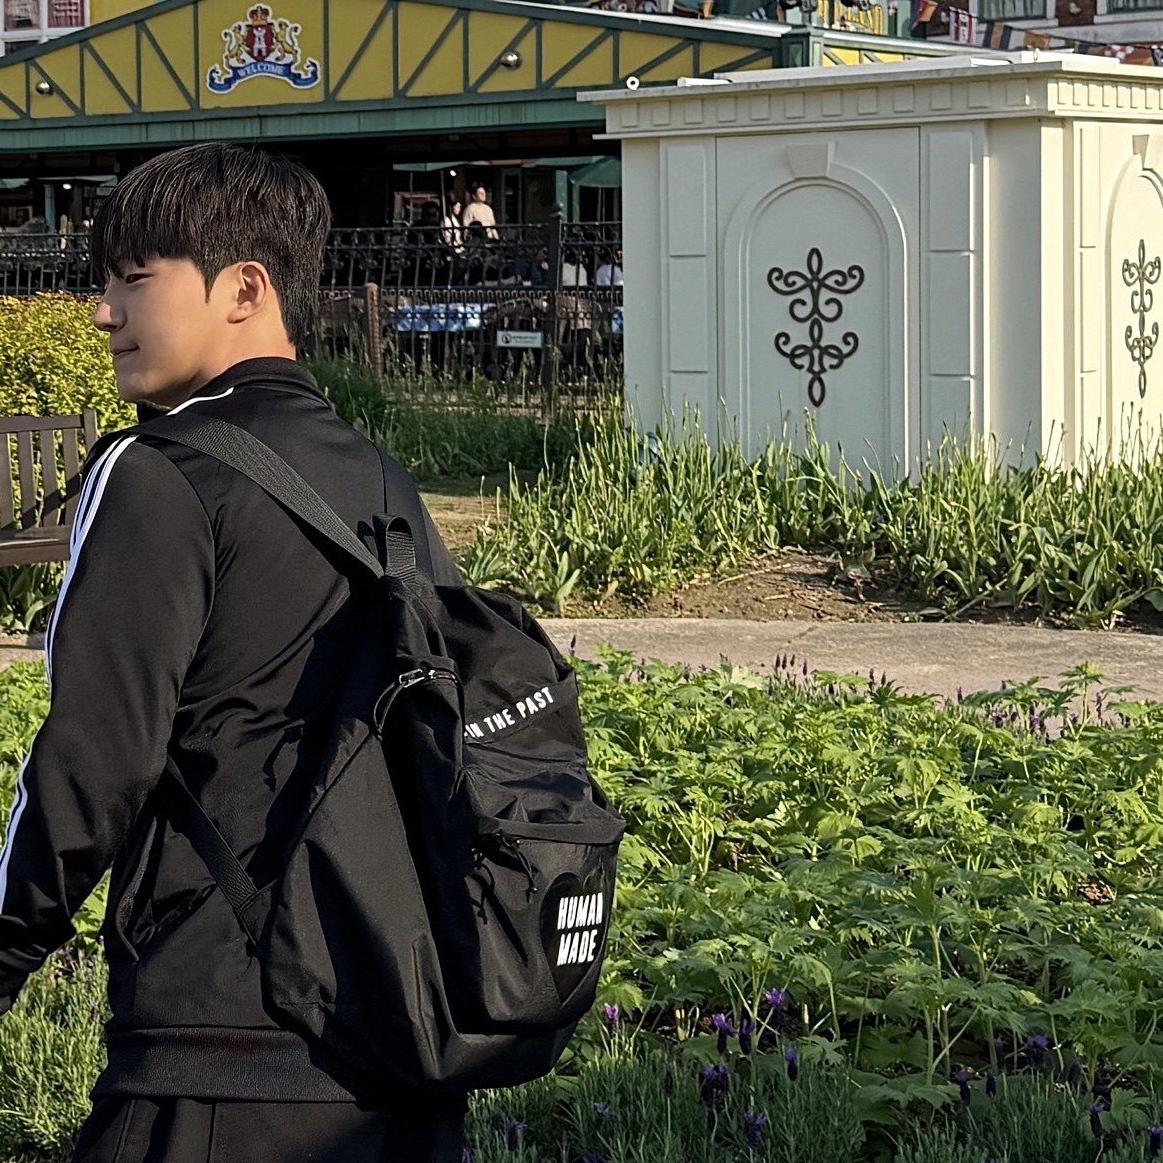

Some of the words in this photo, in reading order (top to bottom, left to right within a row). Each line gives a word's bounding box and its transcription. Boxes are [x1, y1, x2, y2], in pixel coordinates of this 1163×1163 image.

[237, 62, 285, 77] WELCOME
[483, 708, 516, 733] THE
[515, 686, 554, 719] PAST
[557, 892, 603, 930] HUMAN
[557, 929, 598, 967] MADE
